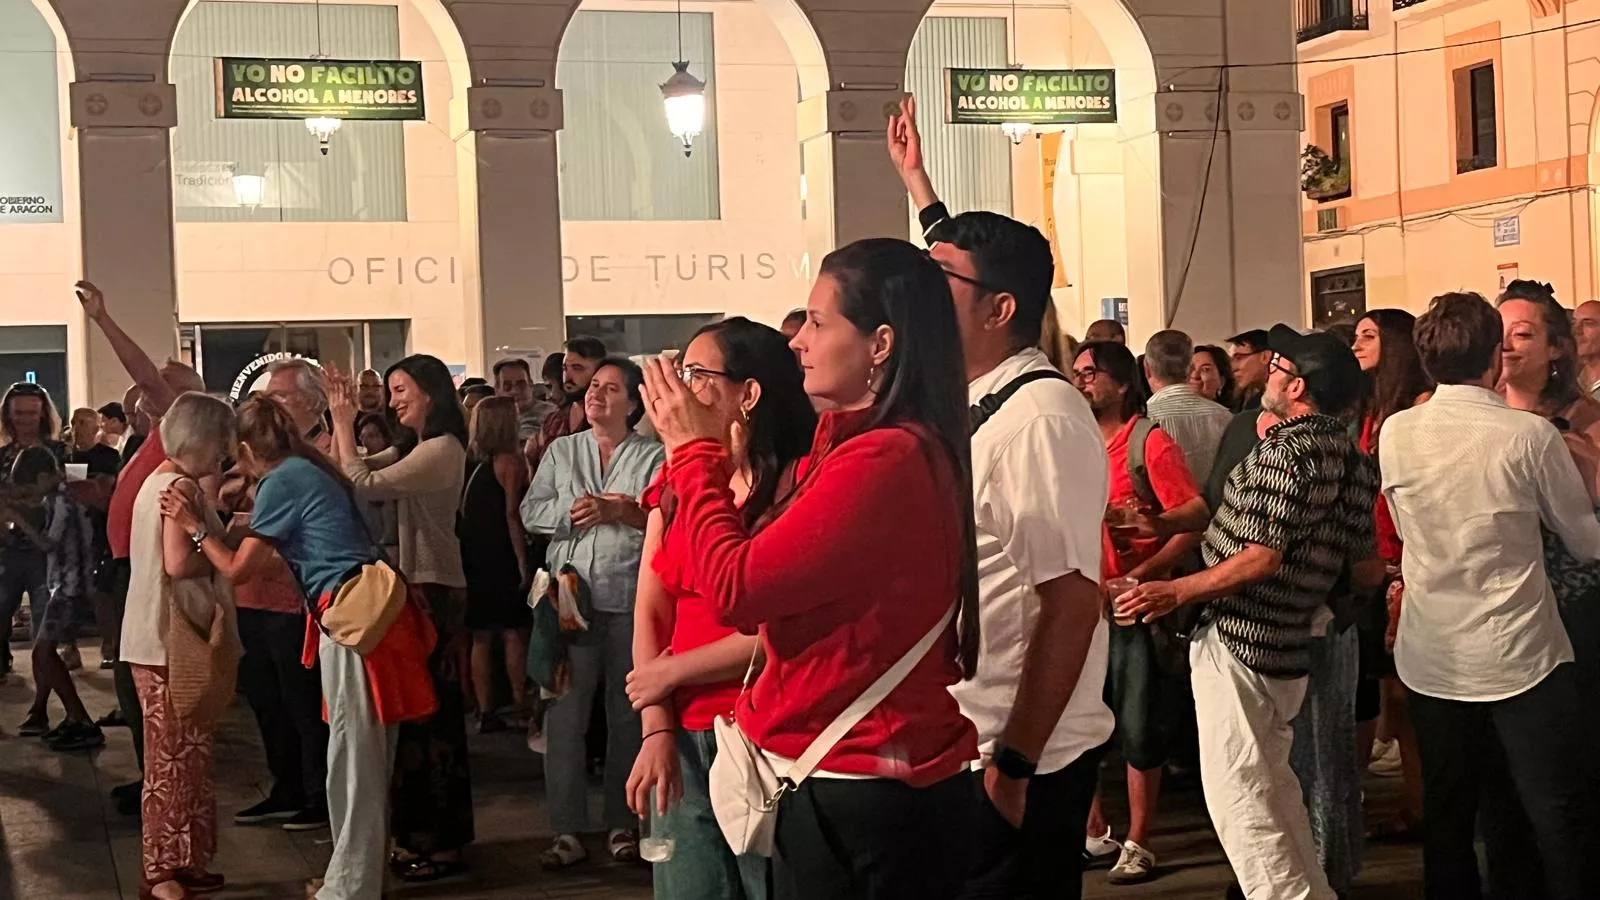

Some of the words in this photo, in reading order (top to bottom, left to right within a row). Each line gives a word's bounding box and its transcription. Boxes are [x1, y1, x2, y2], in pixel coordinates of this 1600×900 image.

[270, 64, 305, 83] NO
[311, 65, 415, 85] FACILITO
[989, 74, 1018, 91] NO
[1023, 75, 1109, 92] FACILITO
[232, 87, 319, 103] ALCOHOL
[323, 88, 335, 103] A
[338, 89, 417, 104] MENORES
[958, 95, 1030, 110] ALCOHOL
[1032, 96, 1043, 109] A
[1045, 96, 1110, 109] MENORES
[0, 196, 45, 205] OBIERNO
[0, 205, 6, 213] E
[328, 256, 456, 285] OFICI
[563, 255, 611, 282] DE
[645, 252, 810, 282] TURISM
[229, 352, 292, 400] BIENVENIDOS
